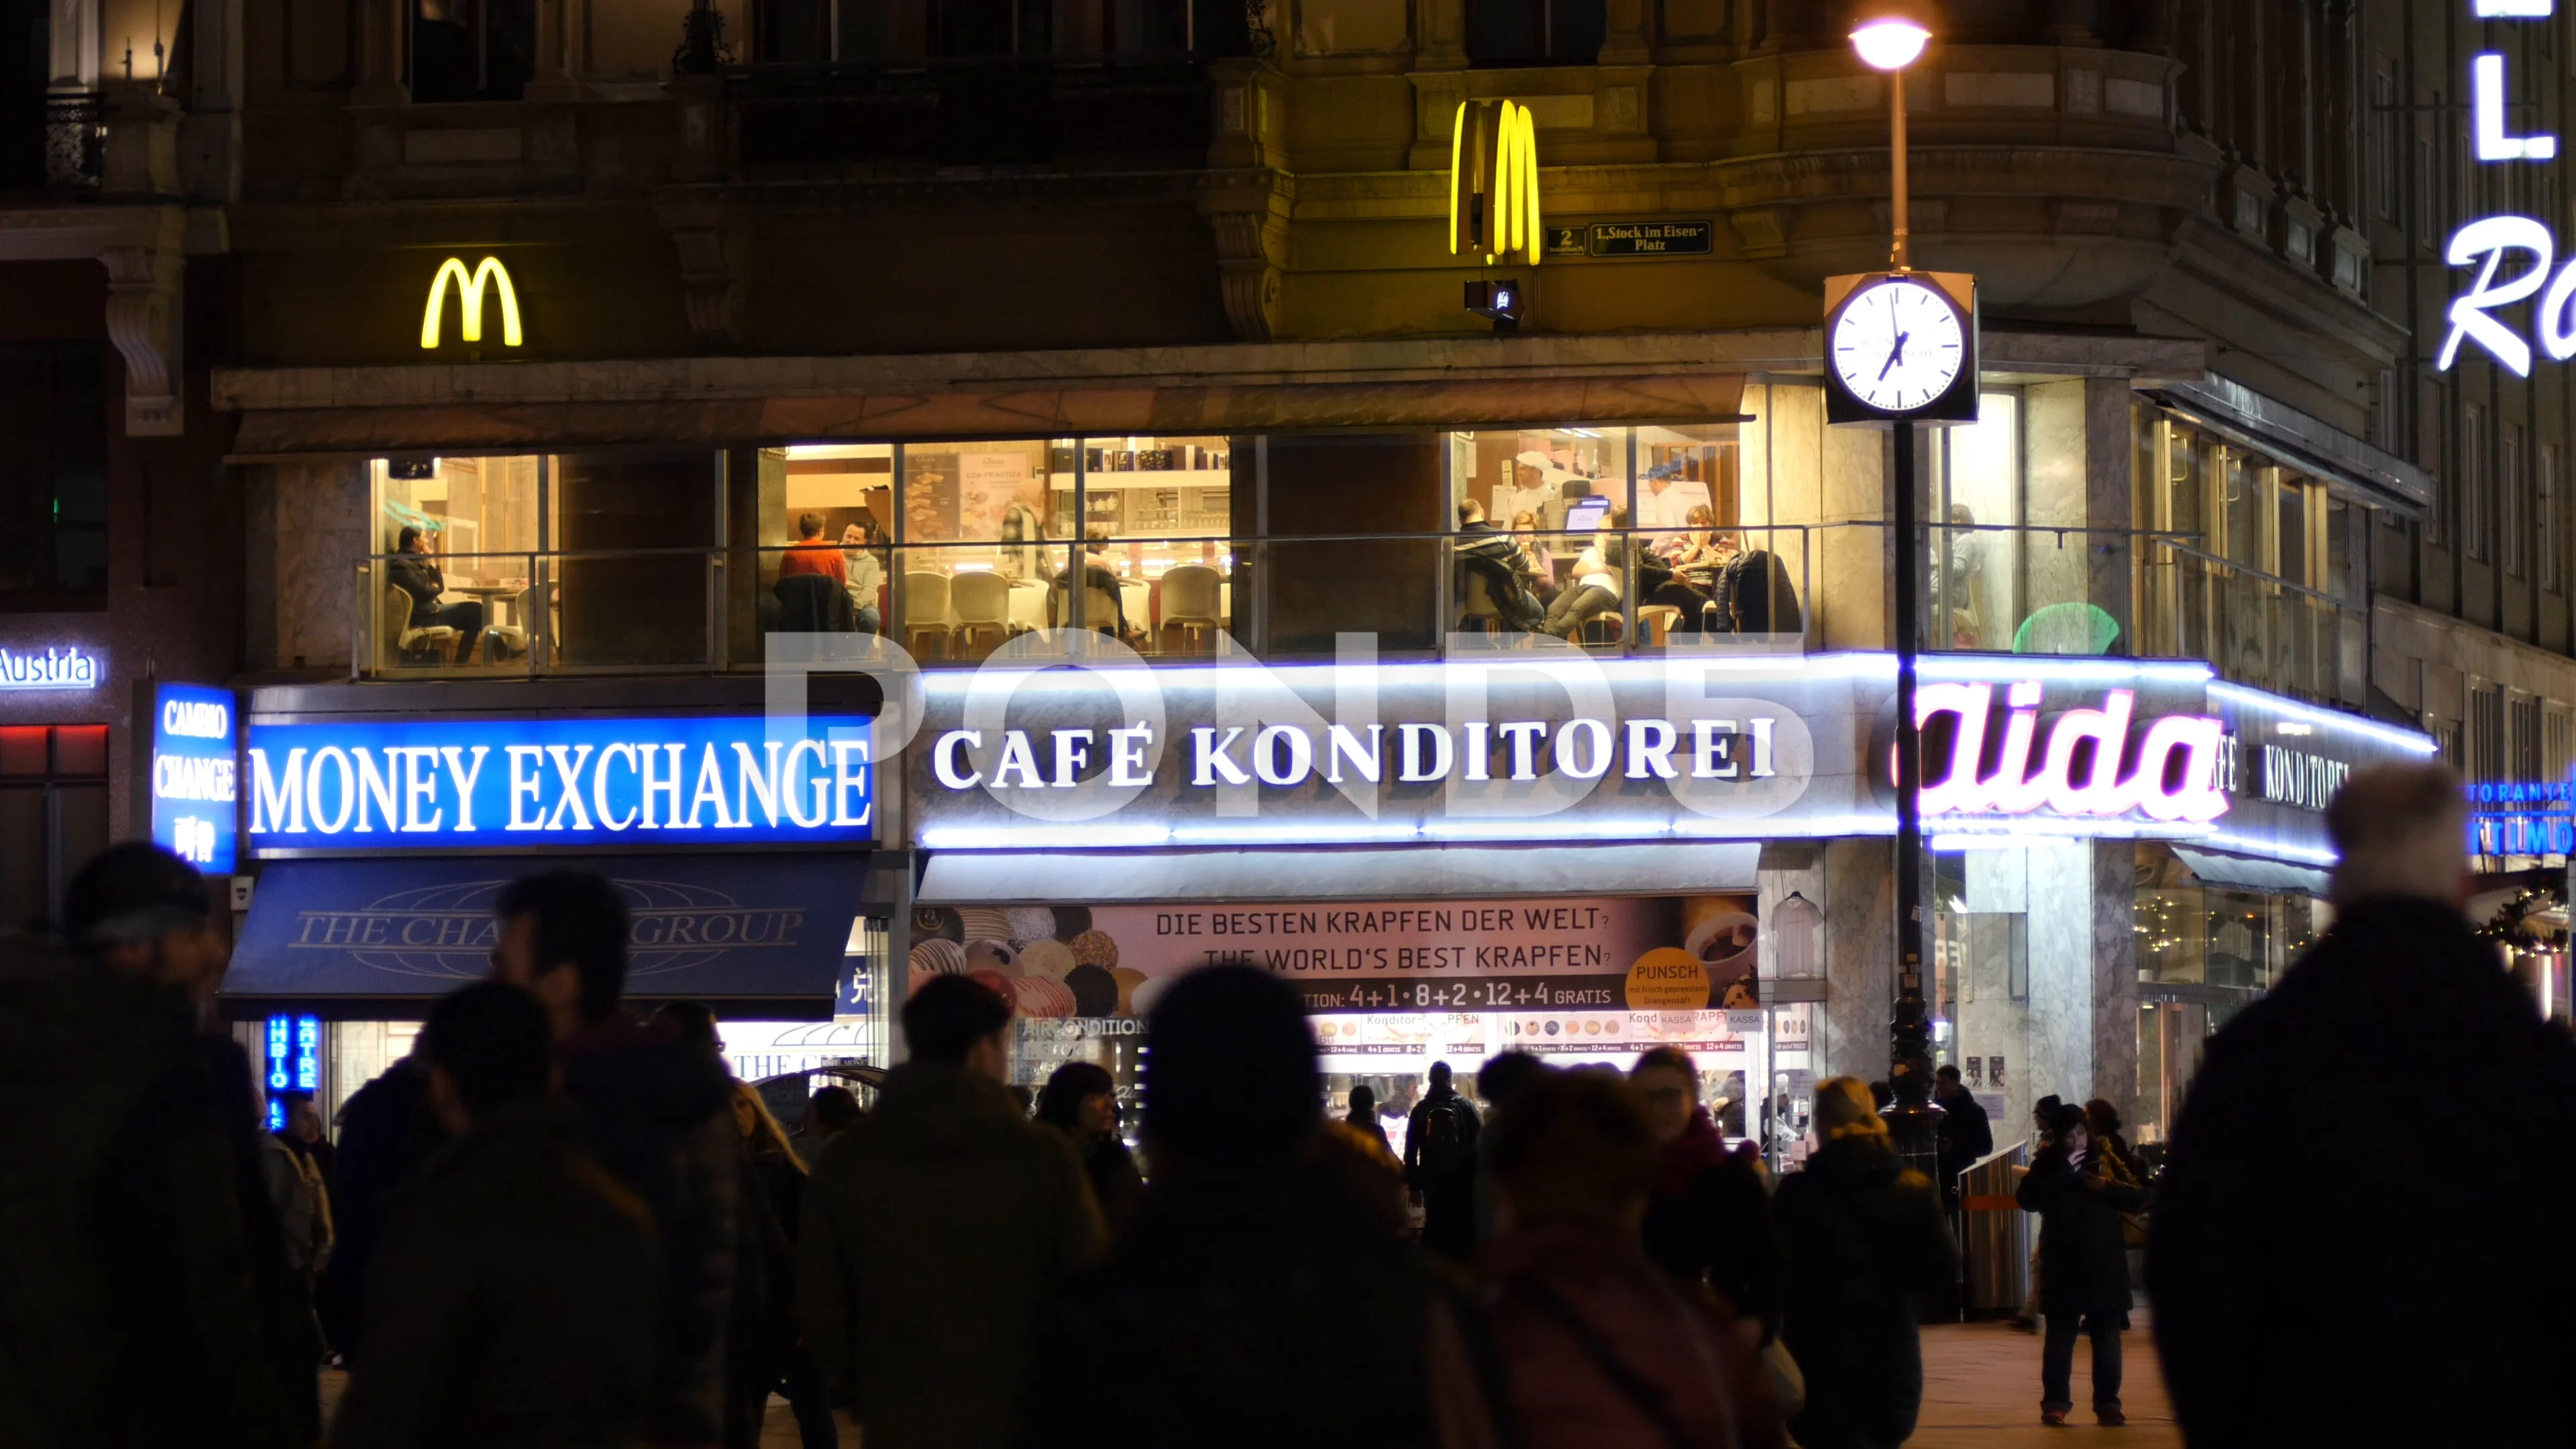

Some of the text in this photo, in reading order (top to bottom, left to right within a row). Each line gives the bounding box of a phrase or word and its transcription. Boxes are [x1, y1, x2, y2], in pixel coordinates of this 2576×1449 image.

[1560, 230, 1572, 246] 2
[1645, 225, 1661, 237] im
[1635, 239, 1666, 251] Platz
[164, 700, 226, 739] CAMBIO
[933, 717, 1776, 790] CAFÉ KONDITOREI
[154, 755, 234, 802] CHANGE
[248, 739, 871, 834] MONEY EXCHANGE
[298, 916, 391, 945] THE
[630, 913, 804, 945] GROUP
[1157, 908, 1609, 935] DIE BESTEN KRAPFEN DER WELT?
[1398, 947, 1466, 969] BEST
[1476, 945, 1611, 968] KRAPFEN?
[1637, 966, 1698, 979] PUNSCH
[1303, 993, 1345, 1008] TION:
[1555, 989, 1611, 1004] GRATIS
[1642, 985, 1663, 994] frisch
[1448, 1014, 1479, 1024] PFEN
[1629, 1012, 1657, 1023] Kond
[1661, 1016, 1692, 1024] KASSA
[1729, 1015, 1761, 1024] KASSA
[300, 1020, 315, 1088] ATRE
[734, 1055, 791, 1078] THE
